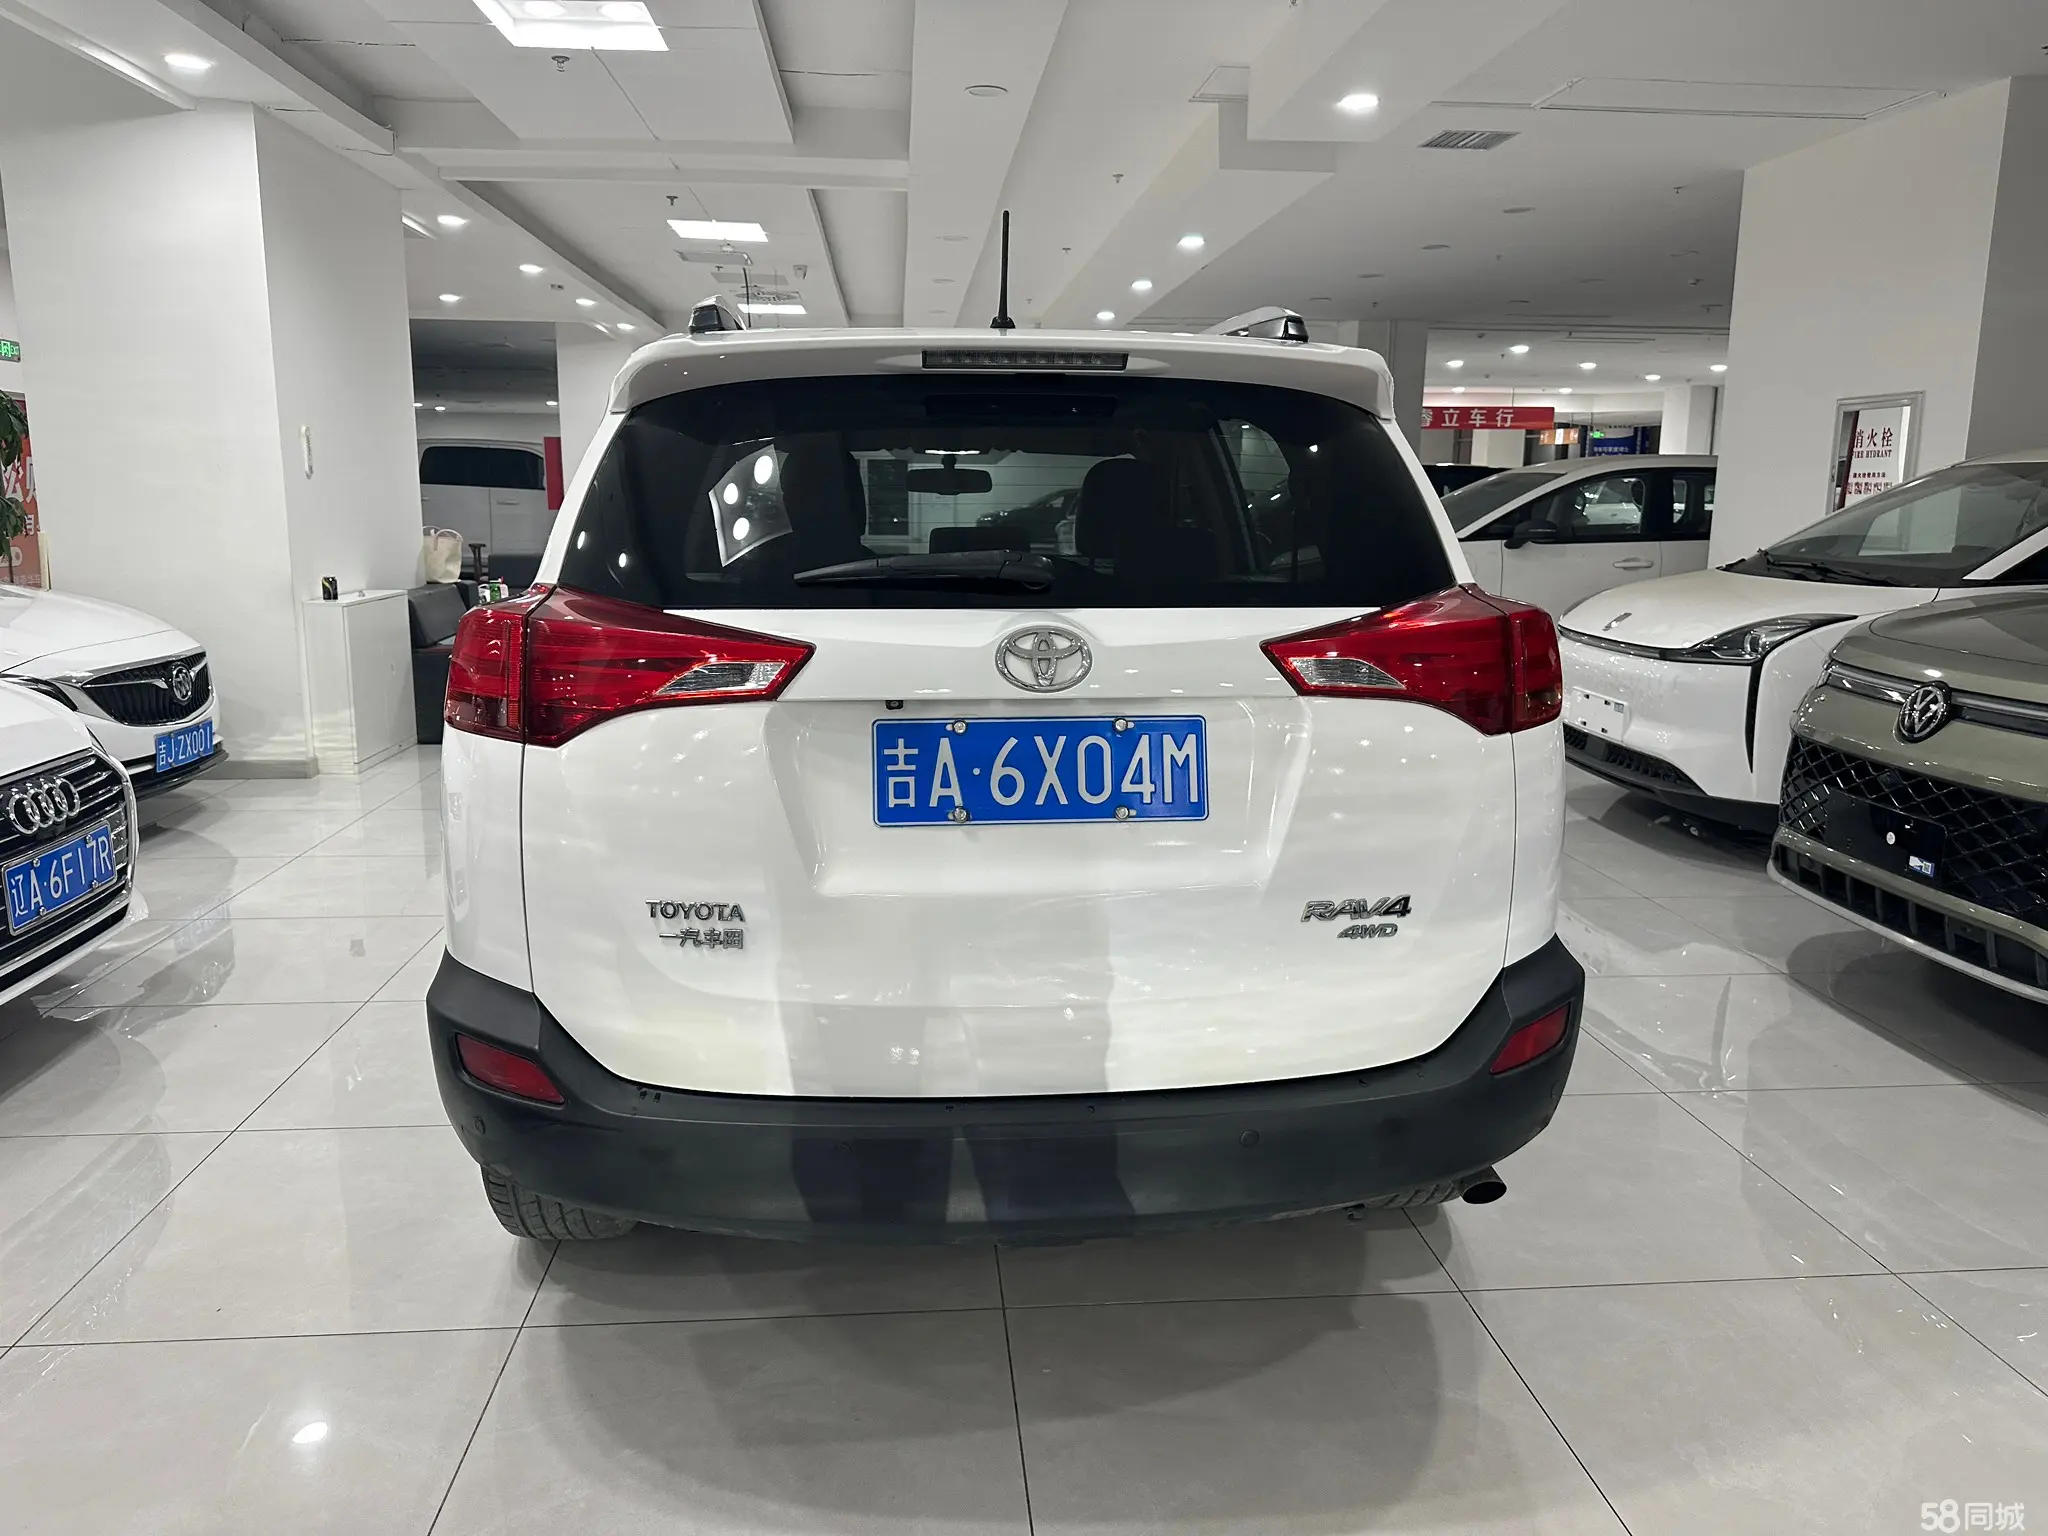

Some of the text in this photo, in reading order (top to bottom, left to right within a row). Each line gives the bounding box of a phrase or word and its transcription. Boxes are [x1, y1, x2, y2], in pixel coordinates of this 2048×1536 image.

[1865, 449, 1892, 459] HYDRANT
[158, 726, 211, 767] 吉J·ZX001
[883, 733, 1199, 808] 吉A·6X04M
[10, 836, 112, 918] 辽A·6F17R
[644, 898, 746, 923] TOYOTA
[1300, 893, 1413, 923] RAV4
[659, 927, 744, 950] 一汽丰田
[1336, 922, 1399, 940] 4WD
